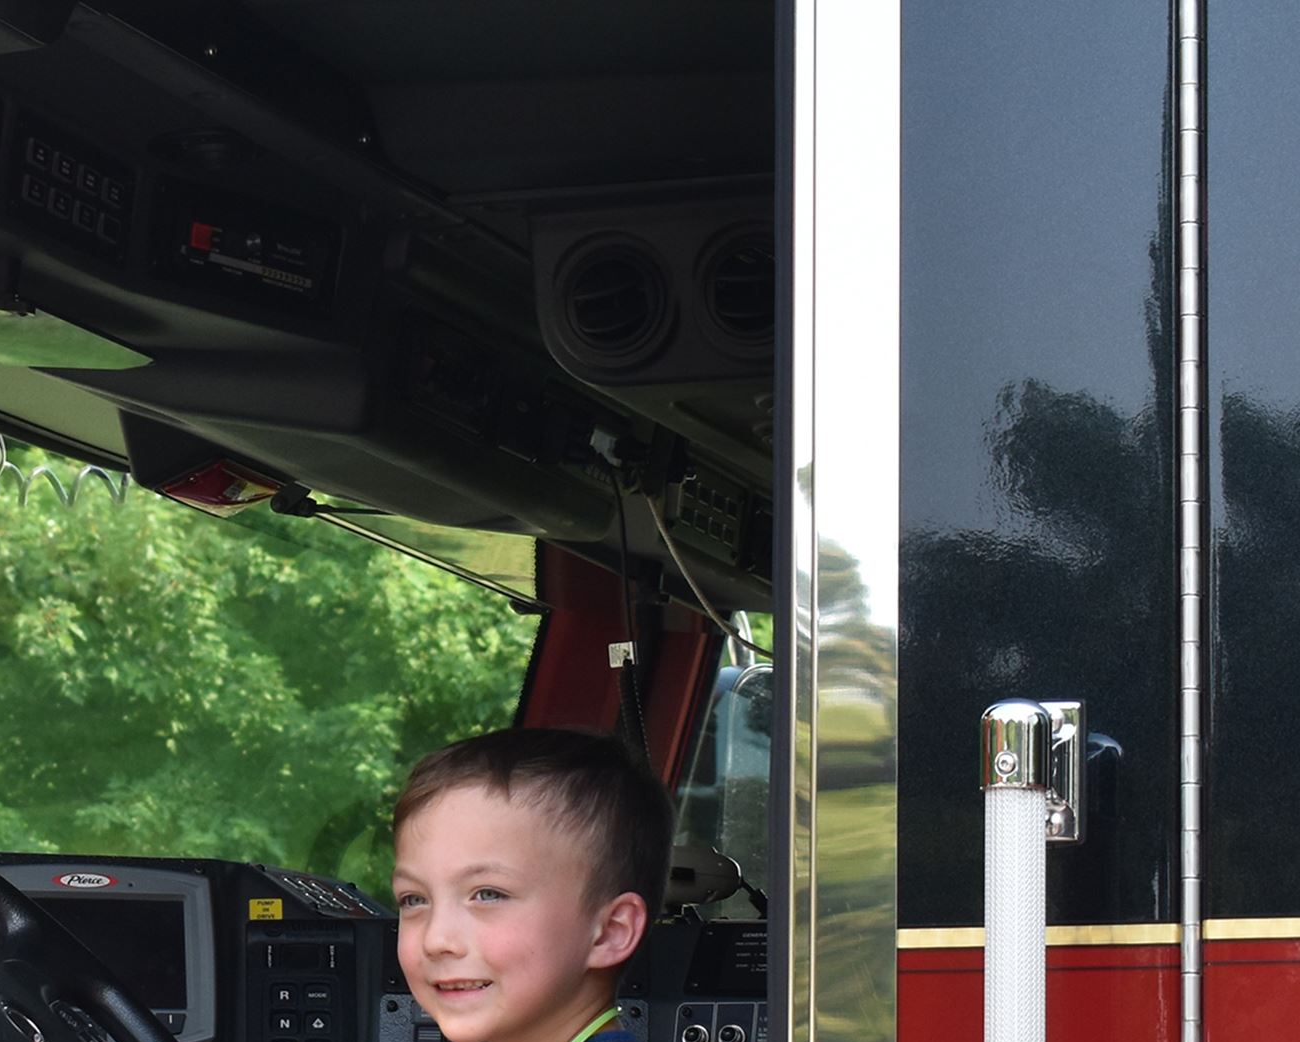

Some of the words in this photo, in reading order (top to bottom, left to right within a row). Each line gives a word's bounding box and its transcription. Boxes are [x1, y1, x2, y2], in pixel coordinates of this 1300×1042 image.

[67, 874, 103, 885] Pierce
[279, 990, 289, 1000] R
[280, 1018, 290, 1028] N
